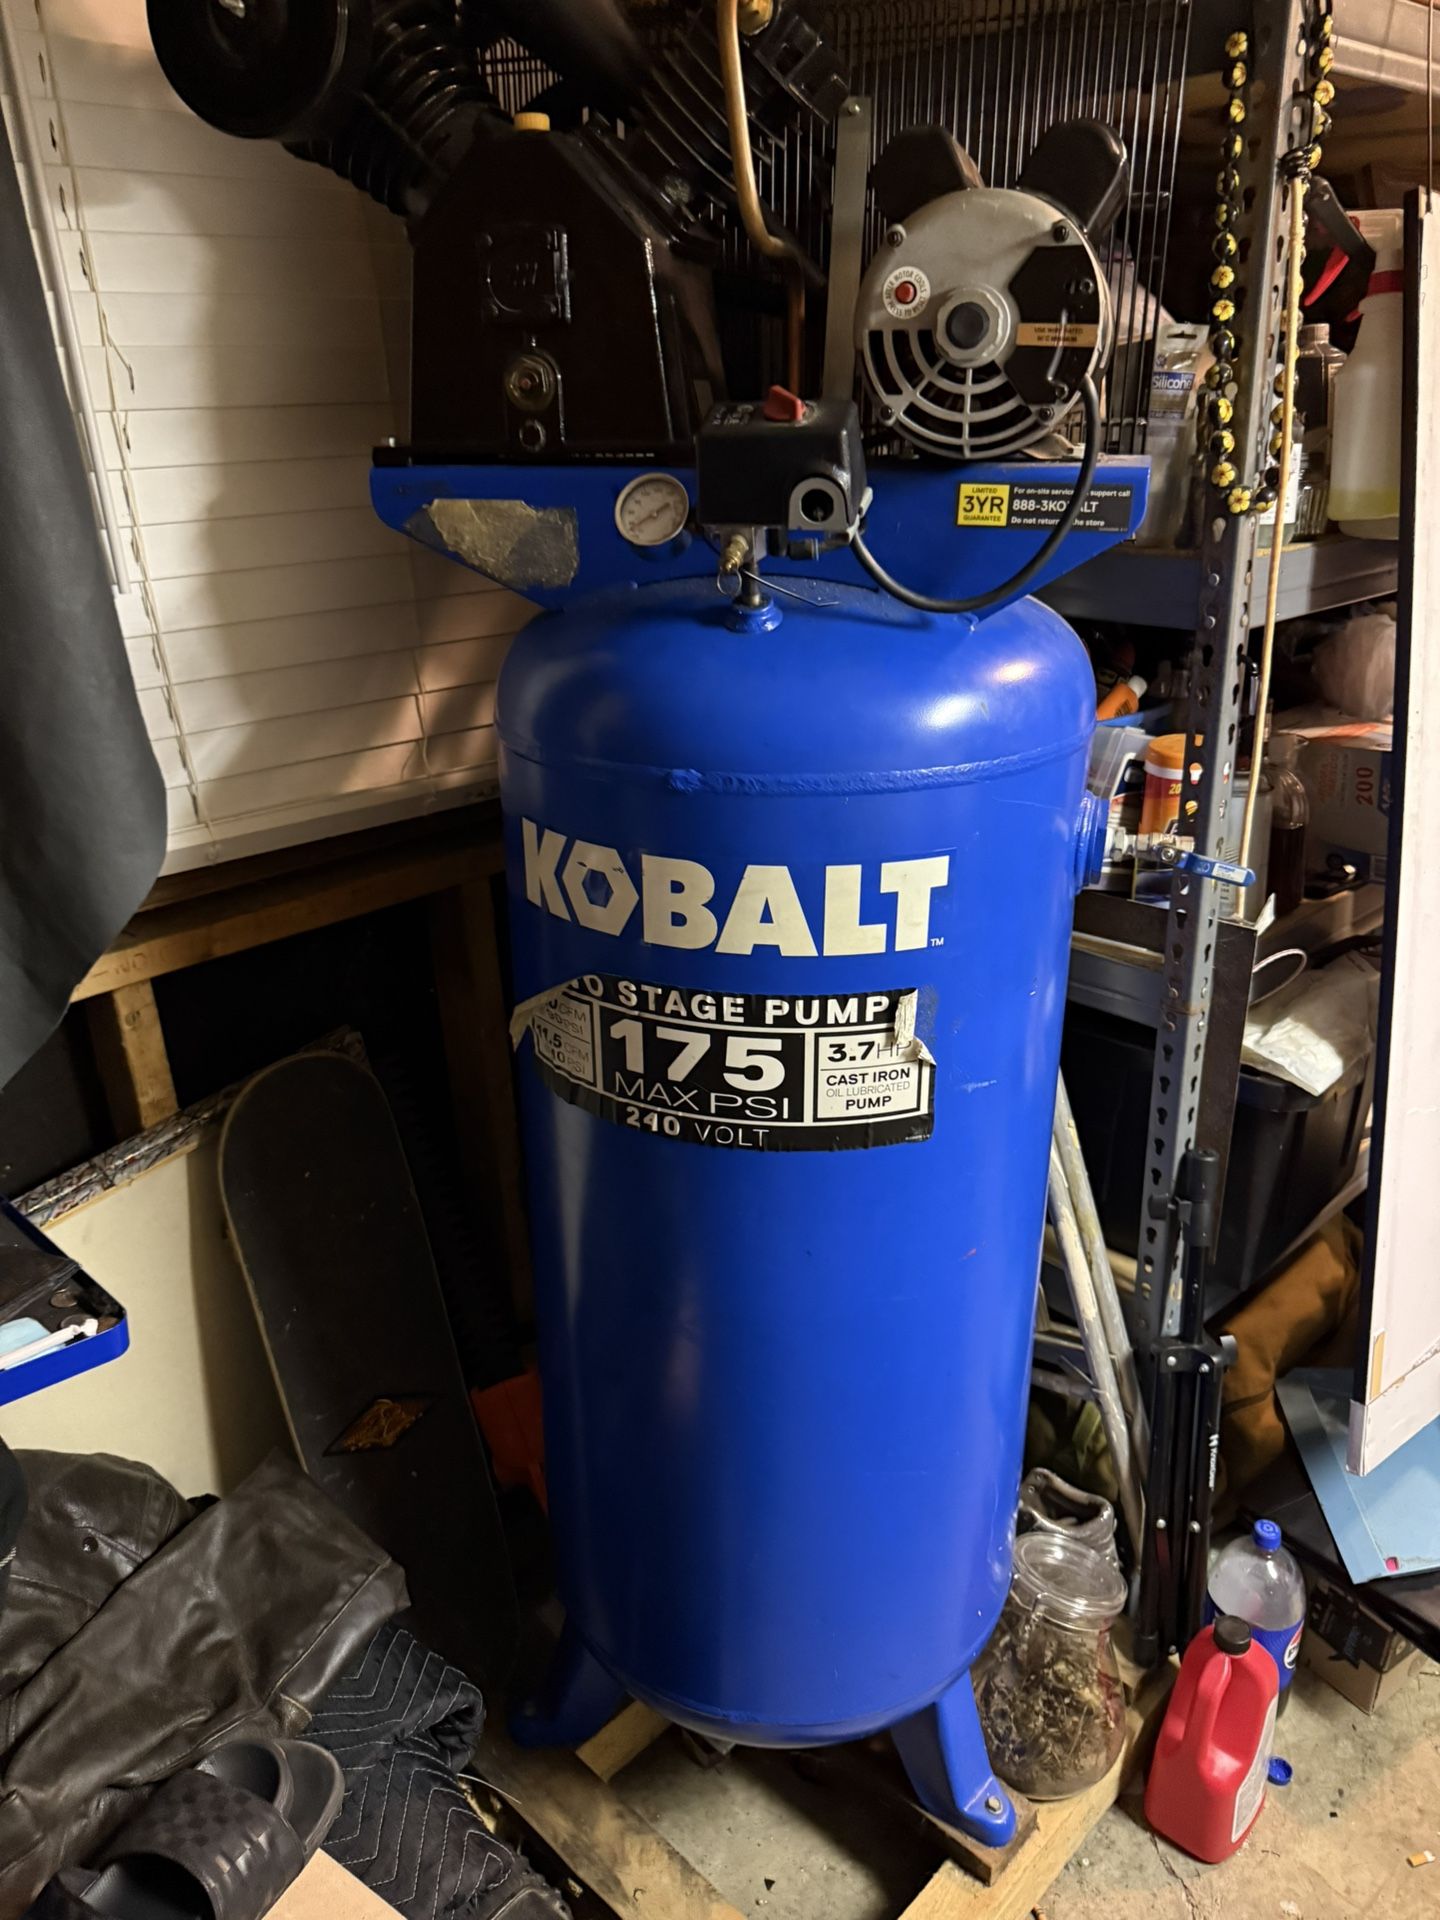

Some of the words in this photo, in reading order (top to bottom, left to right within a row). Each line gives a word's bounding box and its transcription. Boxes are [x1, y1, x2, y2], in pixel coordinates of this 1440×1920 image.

[1153, 374, 1193, 389] Silicone
[1013, 486, 1025, 494] For
[1026, 487, 1050, 495] on-site
[1090, 490, 1117, 498] support
[963, 495, 1004, 514] 3YR
[1012, 499, 1099, 513] 888-3KOLT
[1011, 516, 1022, 524] Do
[1356, 767, 1373, 806] 200
[522, 817, 949, 957] KOBALT
[618, 981, 748, 1024] STAGE
[765, 995, 890, 1026] PUMP
[609, 1018, 787, 1093] 175
[826, 1073, 869, 1086] CAST
[873, 1067, 911, 1083] IRON
[615, 1071, 699, 1112] MAX
[710, 1092, 790, 1120] PSI
[826, 1087, 844, 1098] OIL
[846, 1081, 911, 1096] LUBRICATED
[845, 1095, 892, 1110] PUMP
[626, 1105, 681, 1137] 240
[695, 1123, 770, 1148] VOLT
